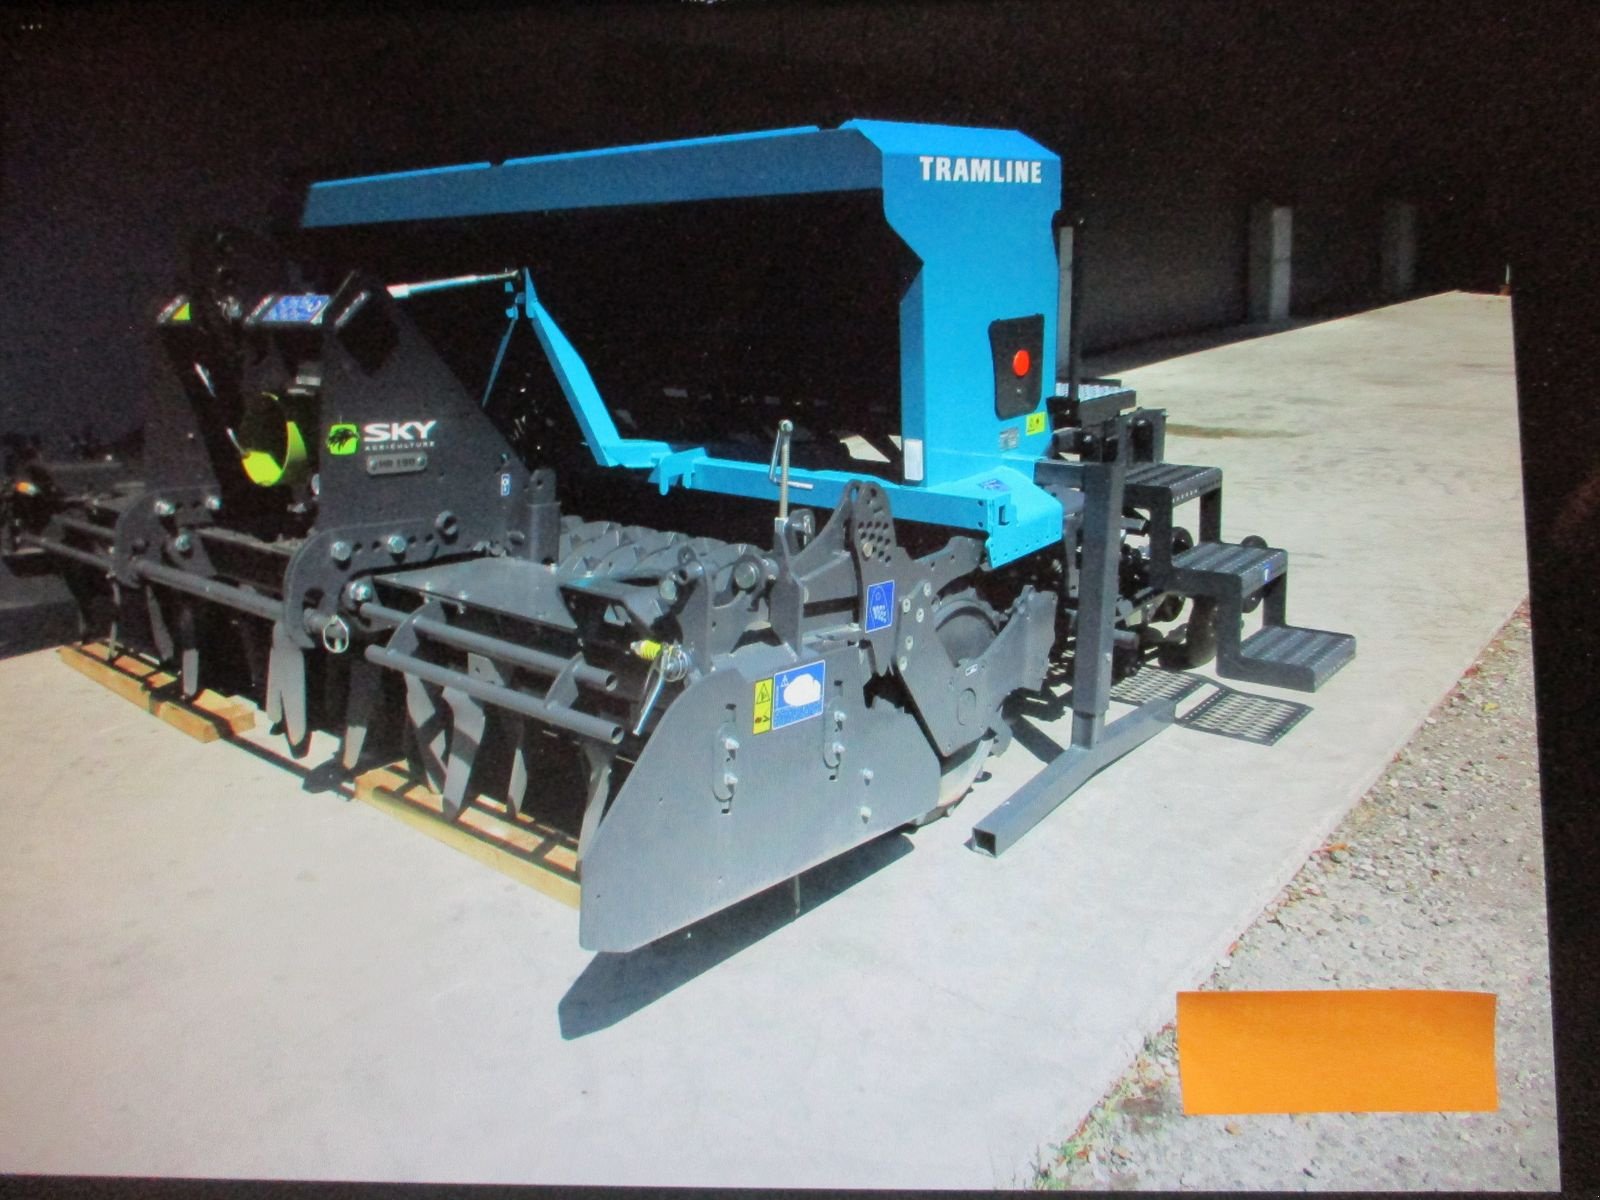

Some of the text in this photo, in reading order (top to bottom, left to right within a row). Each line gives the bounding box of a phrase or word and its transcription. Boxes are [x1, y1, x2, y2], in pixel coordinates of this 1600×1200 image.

[919, 156, 1042, 183] TRAMLINE
[363, 420, 437, 442] SKY
[364, 441, 435, 451] AGRICULTURE
